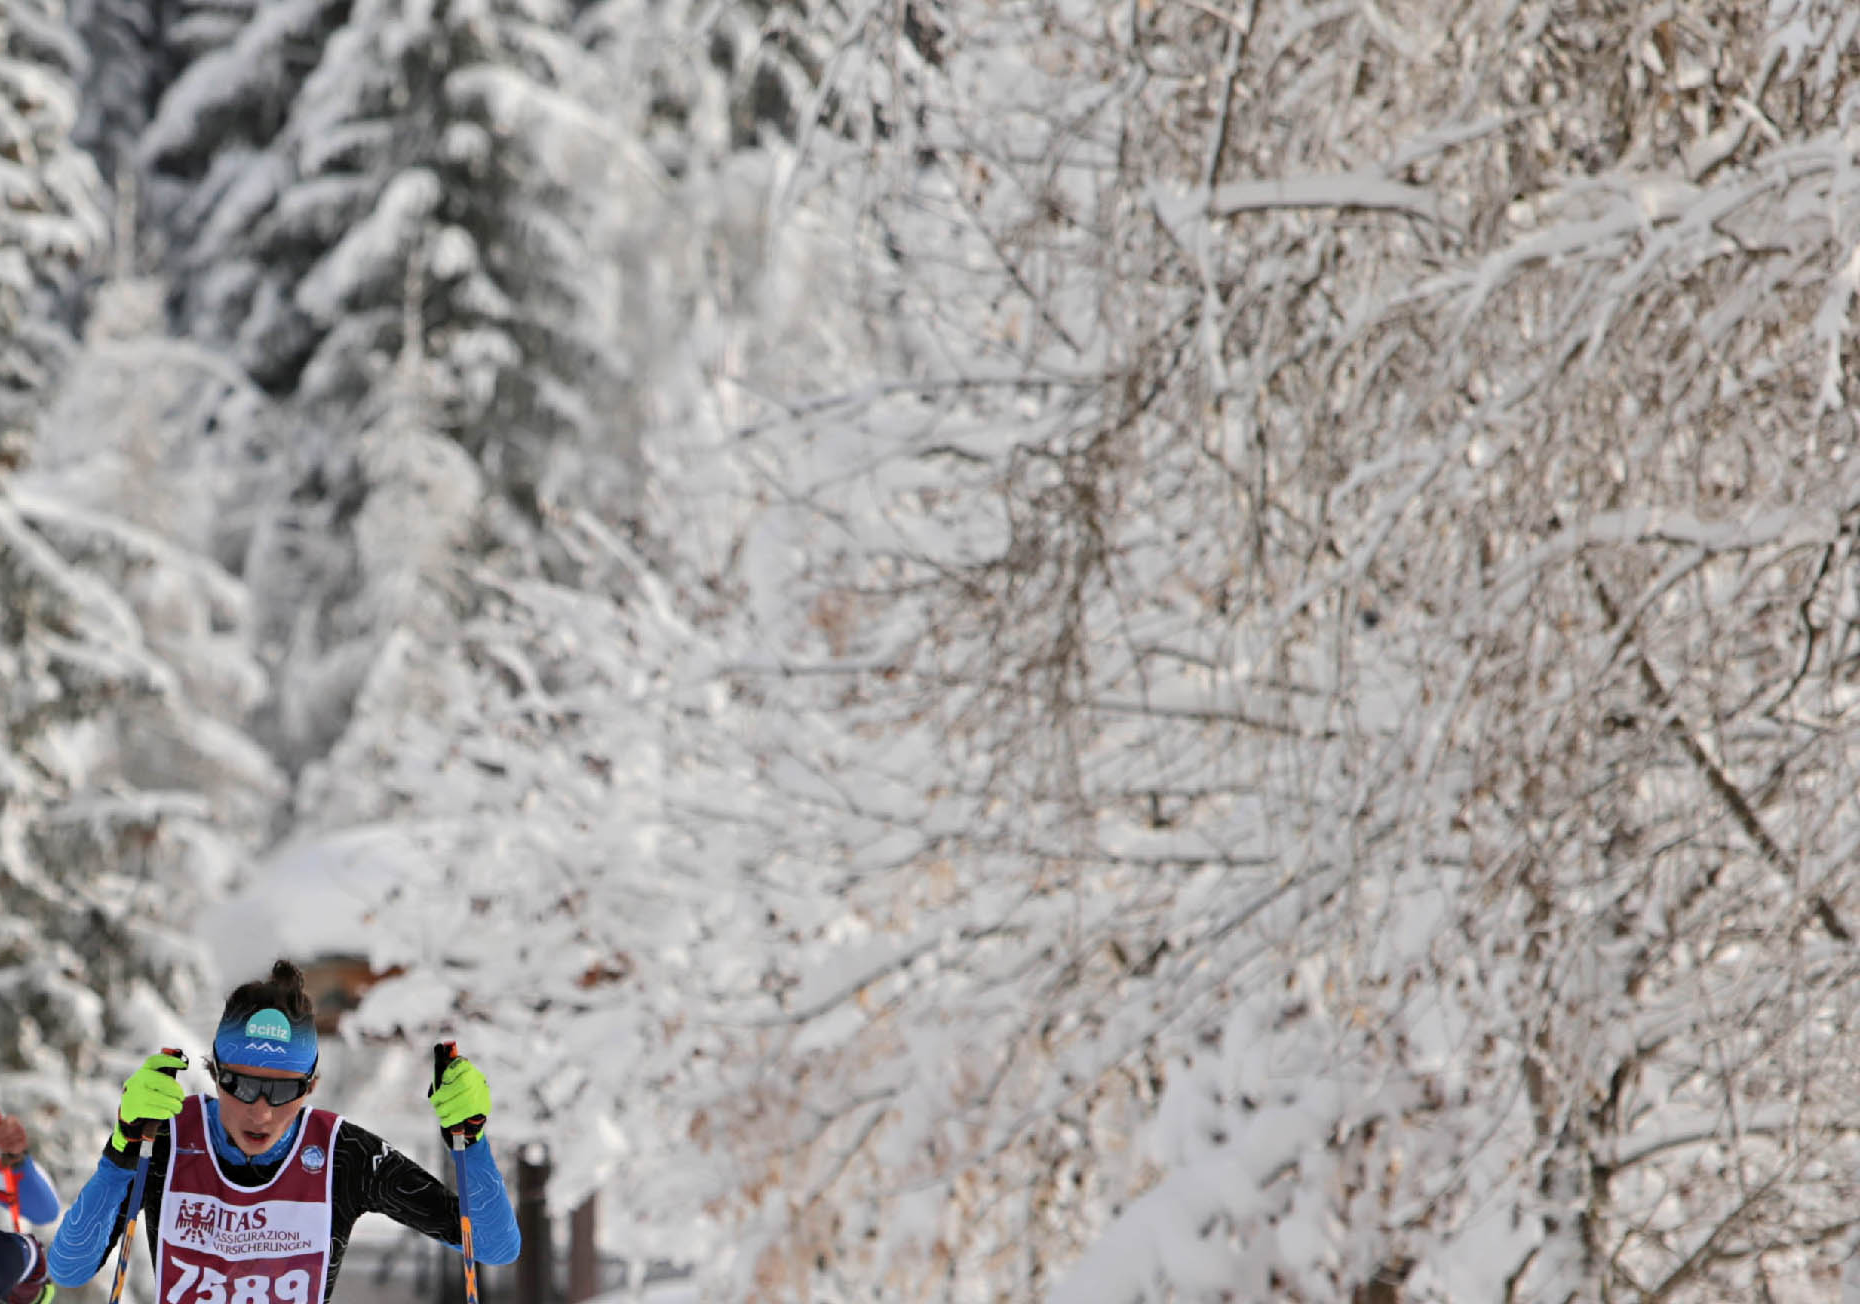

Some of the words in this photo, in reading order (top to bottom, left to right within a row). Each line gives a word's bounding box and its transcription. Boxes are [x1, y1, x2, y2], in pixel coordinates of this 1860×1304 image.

[257, 1024, 288, 1039] citiz
[217, 1207, 268, 1234] ITAS
[213, 1230, 300, 1244] ASSICURAZIONI
[212, 1239, 312, 1255] VERSICHERUNGEN
